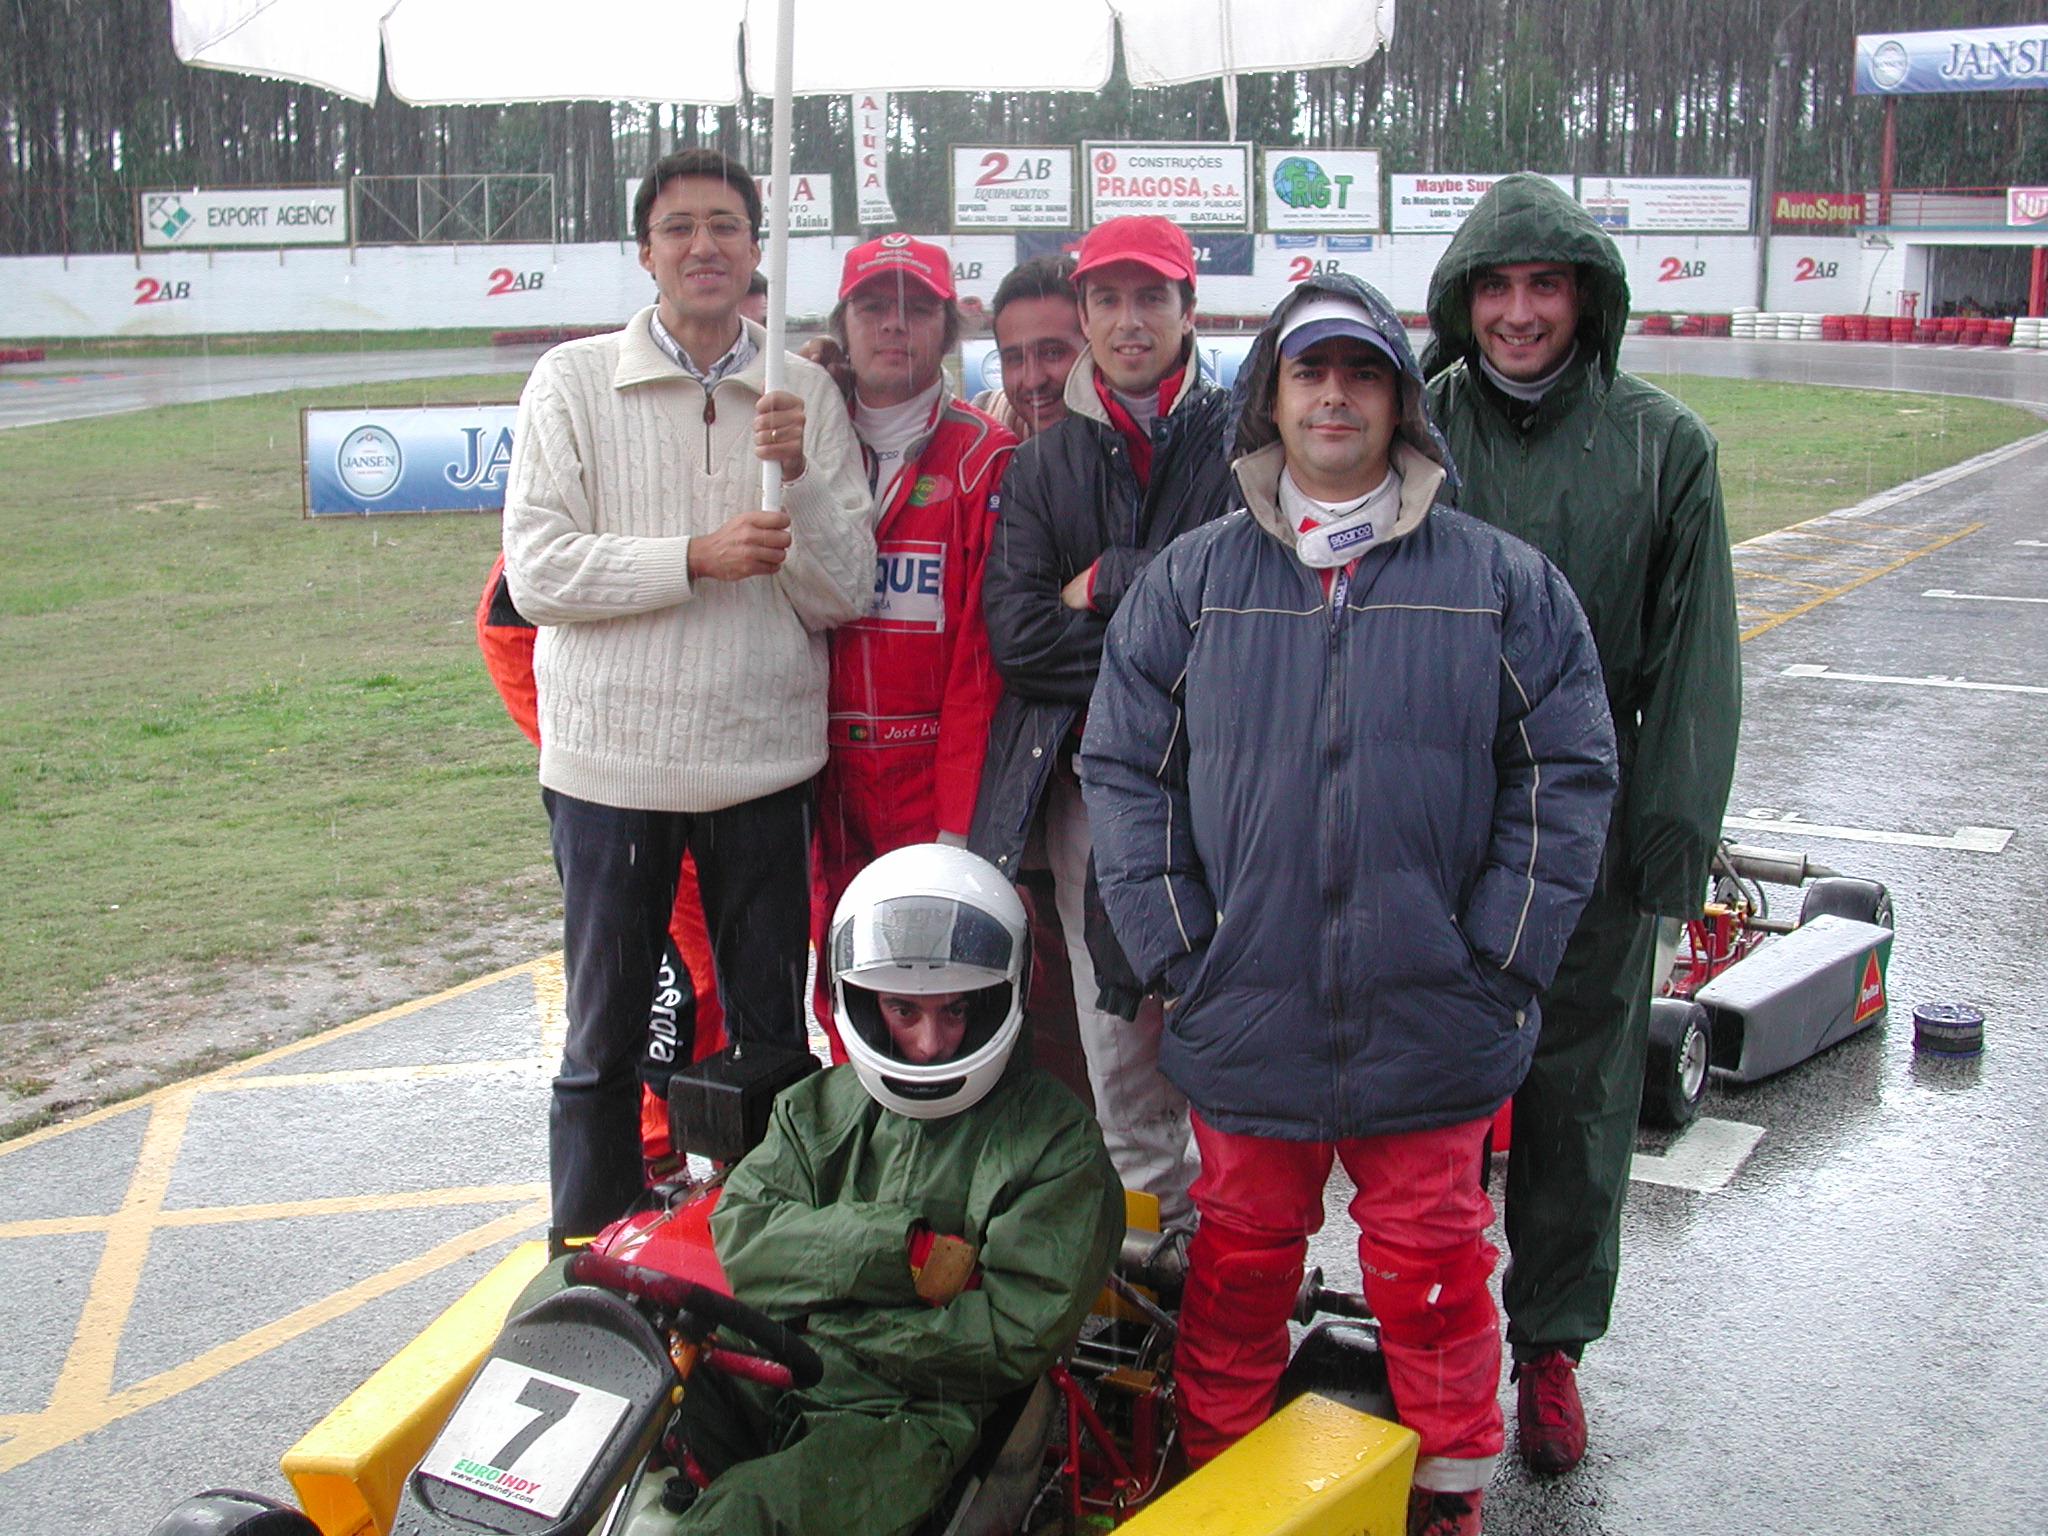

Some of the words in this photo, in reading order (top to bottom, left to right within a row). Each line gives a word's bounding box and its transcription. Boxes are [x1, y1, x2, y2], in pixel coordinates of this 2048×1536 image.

[1129, 155, 1223, 170] CONSTRUÇÕES
[1096, 176, 1208, 199] PRAGOSA,
[1212, 184, 1239, 197] S.A.
[1416, 178, 1463, 193] Maybe
[207, 206, 268, 227] EXPORT
[276, 204, 336, 226] AGENCY
[1191, 213, 1243, 221] BATALHA
[1775, 197, 1860, 221] AutoSport
[796, 215, 828, 227] Rainha
[343, 455, 396, 469] JANSEN
[1329, 524, 1372, 548] sparco
[884, 724, 917, 739] José
[487, 1377, 581, 1471] 7
[450, 1469, 535, 1504] www.euroindy.com
[454, 1458, 542, 1495] EUROINDY
